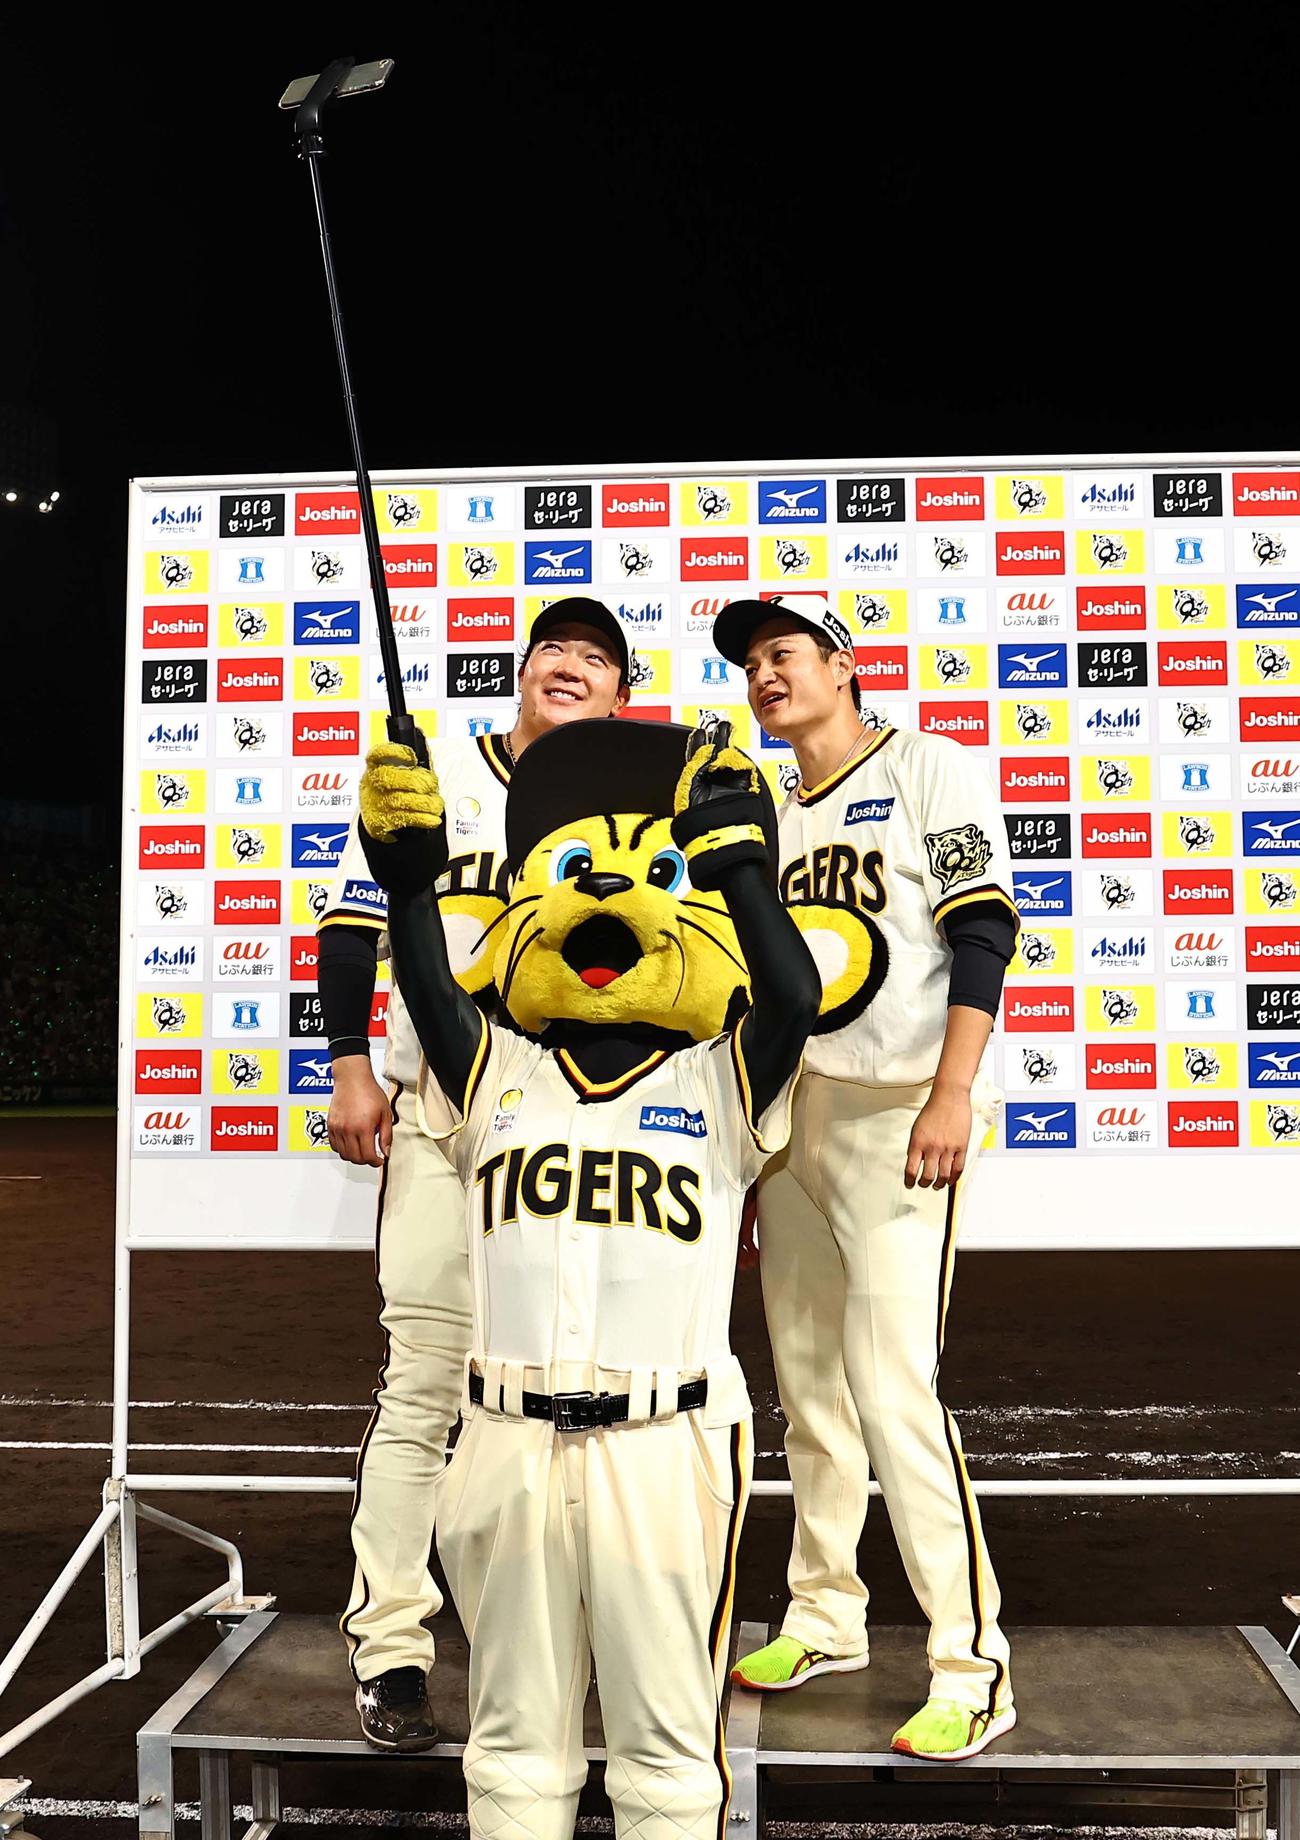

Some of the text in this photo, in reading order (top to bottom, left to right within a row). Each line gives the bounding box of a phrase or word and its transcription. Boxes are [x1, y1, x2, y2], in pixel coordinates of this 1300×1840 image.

[921, 492, 979, 506] Joshin
[1081, 484, 1134, 502] Asahi
[1238, 487, 1297, 501] Joshin
[607, 498, 665, 513] Joshin
[152, 507, 201, 524] Asahi
[300, 506, 356, 521] Joshin
[686, 552, 744, 566] Joshin
[845, 544, 897, 561] Asahi
[1001, 546, 1060, 560] Joshin
[1007, 593, 1053, 611] au
[1082, 601, 1141, 615] Joshin
[452, 612, 509, 627] Joshin
[1002, 615, 1059, 626] じぶん銀行
[148, 620, 203, 634] Joshin
[823, 615, 851, 647] Josh
[856, 661, 903, 675] oshin
[1163, 656, 1222, 671] Joshin
[222, 673, 278, 687] Joshin
[925, 716, 984, 731] Joshin
[1087, 709, 1140, 728] Asahi
[148, 725, 198, 743] Asahi
[298, 727, 354, 741] Joshin
[1251, 759, 1297, 777] au
[302, 773, 348, 791] au
[1006, 772, 1065, 786] Joshin
[297, 795, 352, 806] じぶん銀行
[847, 805, 892, 823] Joshin
[1087, 828, 1146, 843] Joshin
[144, 840, 200, 854] Joshin
[779, 843, 888, 916] GERS
[346, 886, 388, 905] Josh
[1168, 885, 1228, 899] Joshin
[220, 895, 276, 909] Joshin
[1091, 938, 1145, 957] Asahi
[1175, 932, 1221, 951] au
[144, 947, 195, 965] Asahi
[224, 942, 270, 960] au
[1251, 942, 1300, 956] Joshi
[1170, 955, 1228, 967] じぶん銀行
[219, 964, 273, 975] じぶん銀行
[1009, 1002, 1069, 1016] Joshin
[298, 1018, 325, 1032] セ・リ
[141, 1065, 197, 1079] Joshin
[1091, 1059, 1151, 1073] Joshin
[297, 1078, 333, 1086] MIZU
[144, 1112, 190, 1130] au
[642, 1109, 705, 1133] Joshin
[1097, 1107, 1143, 1126] au
[217, 1122, 273, 1135] Joshin
[1173, 1117, 1234, 1131] Joshin
[139, 1134, 195, 1145] じぶん銀行
[1092, 1131, 1150, 1142] じぶん銀行
[475, 1143, 703, 1245] TIGERS
